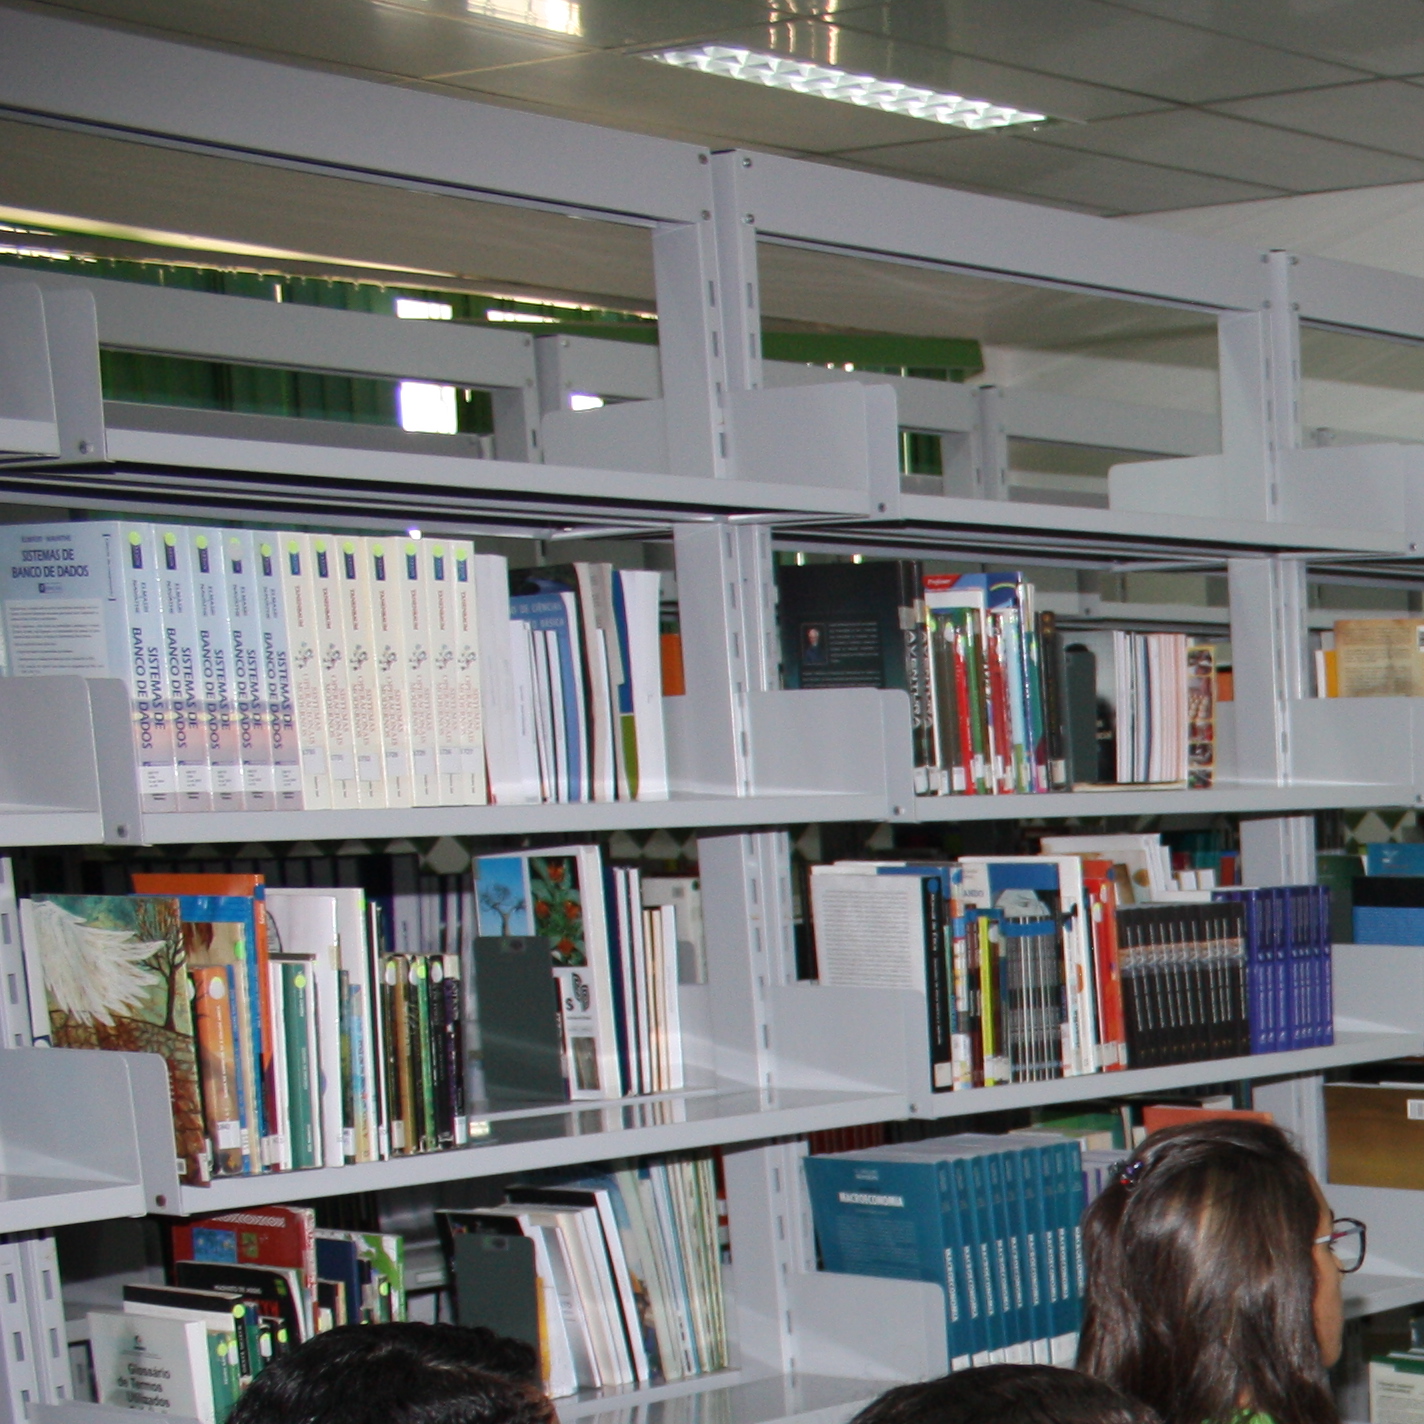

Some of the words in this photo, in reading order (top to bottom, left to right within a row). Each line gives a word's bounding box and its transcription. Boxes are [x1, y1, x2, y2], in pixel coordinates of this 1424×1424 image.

[12, 566, 41, 578] BANCO
[44, 566, 55, 577] DE
[57, 565, 89, 577] DADOS
[22, 549, 60, 561] SISTEMAS
[62, 549, 74, 560] DE
[132, 627, 145, 676] BANCO
[167, 628, 179, 676] BANCO
[200, 630, 212, 678] BANCO
[233, 630, 244, 677] BANCO
[264, 632, 275, 679] BANCO
[137, 680, 148, 698] DE
[148, 646, 164, 710] SISTEMAS
[172, 680, 181, 698] DE
[182, 646, 197, 709] SISTEMAS
[206, 682, 215, 699] DE
[215, 649, 229, 709] SISTEMAS
[238, 681, 247, 699] DE
[247, 649, 261, 709] SISTEMAS
[269, 683, 278, 700] DE
[277, 650, 292, 710] SISTEMAS
[908, 630, 922, 729] AVENTURA
[139, 701, 152, 749] DADOS
[154, 712, 165, 730] DE
[174, 701, 187, 749] DADOS
[188, 712, 199, 729] DE
[207, 703, 220, 749] DADOS
[221, 714, 231, 730] DE
[239, 702, 251, 749] DADOS
[252, 713, 262, 730] DE
[270, 703, 282, 749] DADOS
[283, 715, 292, 731] DE
[118, 1376, 128, 1387] de
[130, 1377, 163, 1393] Termos
[127, 1362, 171, 1380] Glossário
[126, 1392, 170, 1408] Utilizados
